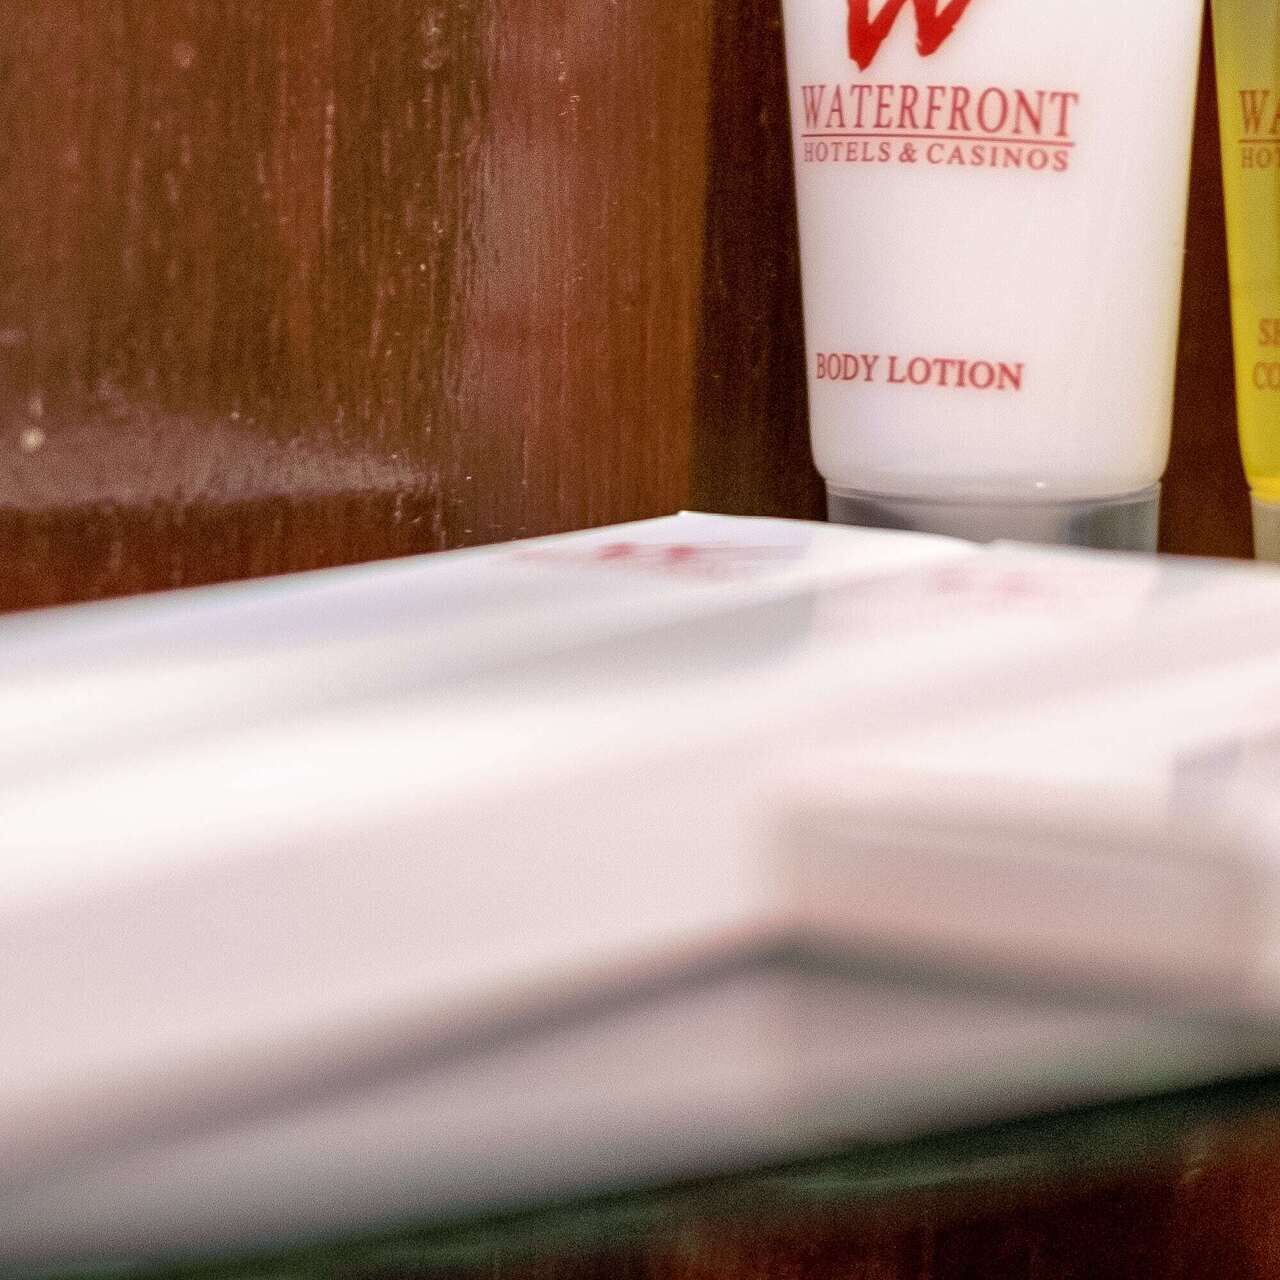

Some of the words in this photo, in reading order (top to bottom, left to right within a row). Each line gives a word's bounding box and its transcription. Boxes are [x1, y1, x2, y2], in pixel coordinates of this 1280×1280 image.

[801, 83, 1080, 138] WATERFRONT
[803, 141, 891, 164] HOTELS
[899, 144, 918, 165] &
[926, 144, 1070, 173] CASINOS
[816, 351, 880, 382] BODY
[887, 356, 1025, 392] LOTION
